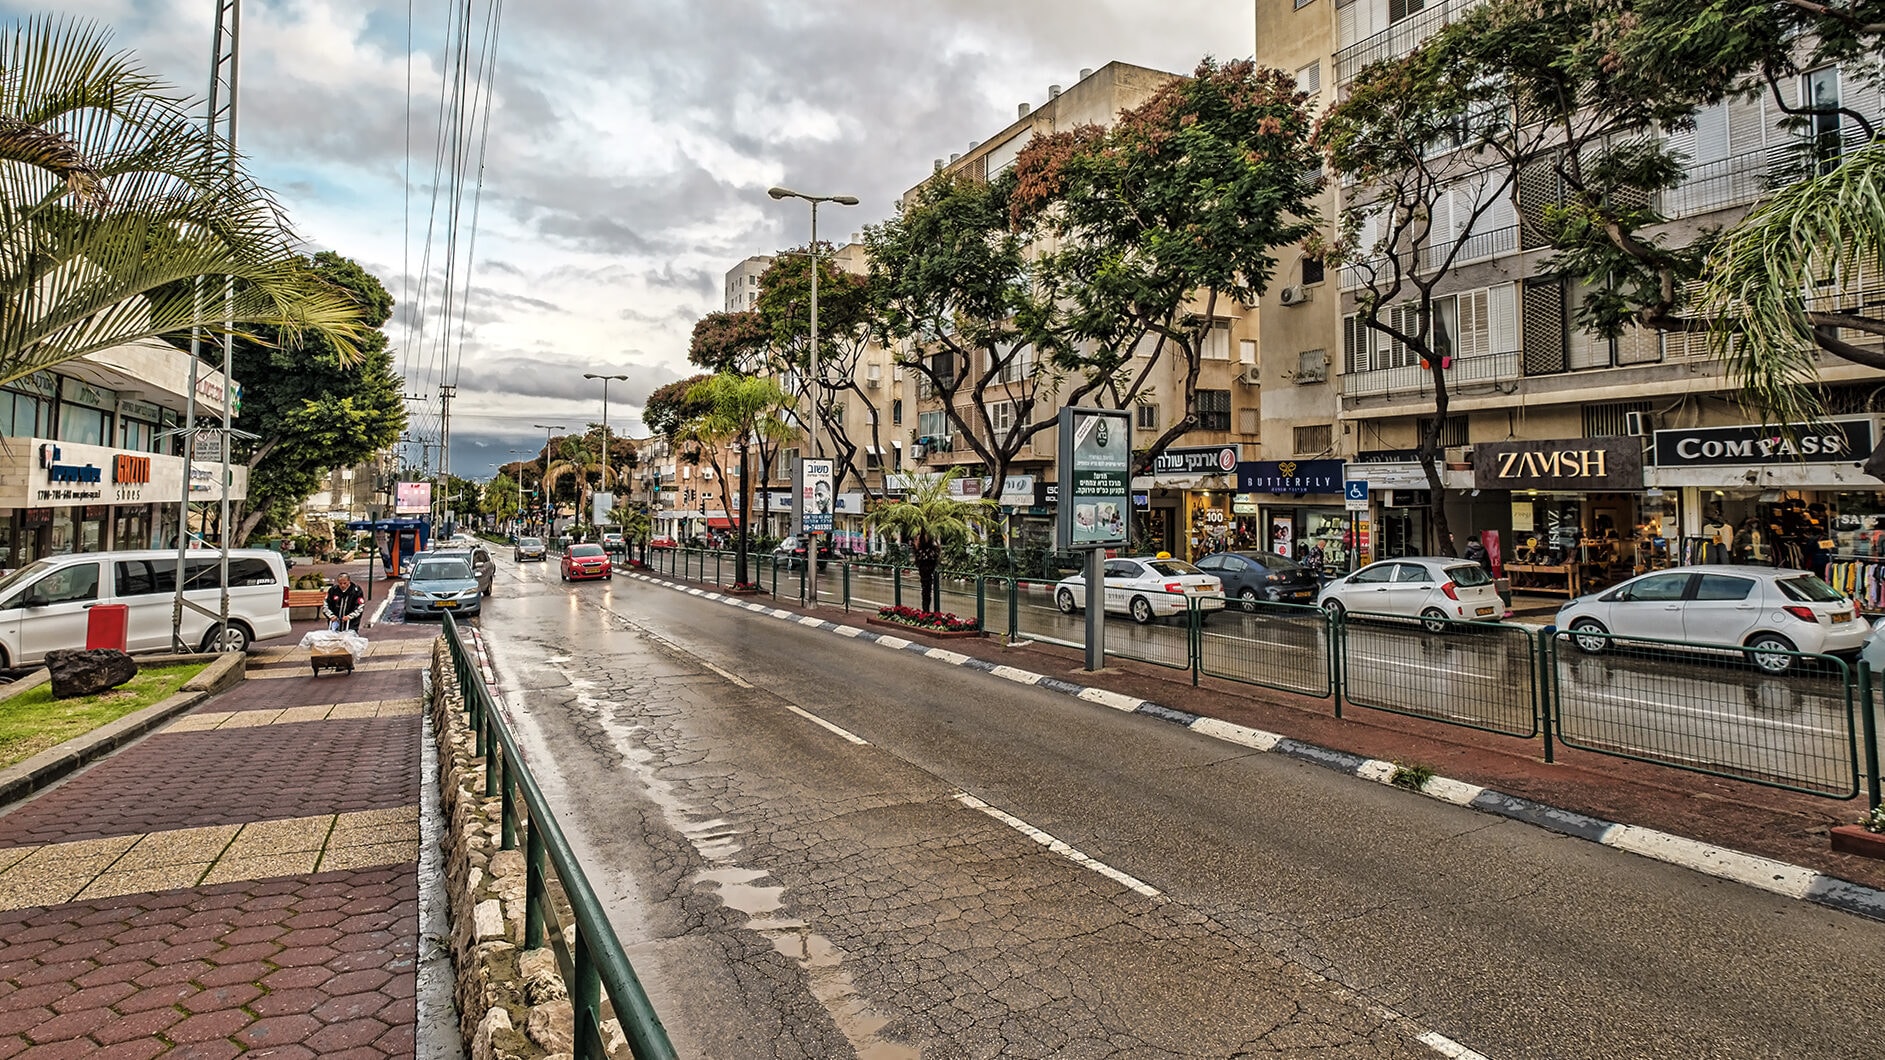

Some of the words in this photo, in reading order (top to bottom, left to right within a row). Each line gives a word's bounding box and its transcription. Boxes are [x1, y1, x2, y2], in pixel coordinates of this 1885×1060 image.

[1157, 451, 1183, 468] שולה
[1185, 453, 1218, 472] ארנקי
[1498, 449, 1608, 478] ZAMSH
[118, 454, 150, 484] GAZITA
[807, 464, 829, 474] משוב
[1247, 476, 1331, 488] BUTTERFLY
[116, 487, 141, 501] shoes
[1206, 512, 1223, 523] 100
[1548, 510, 1560, 551] ZAMSH
